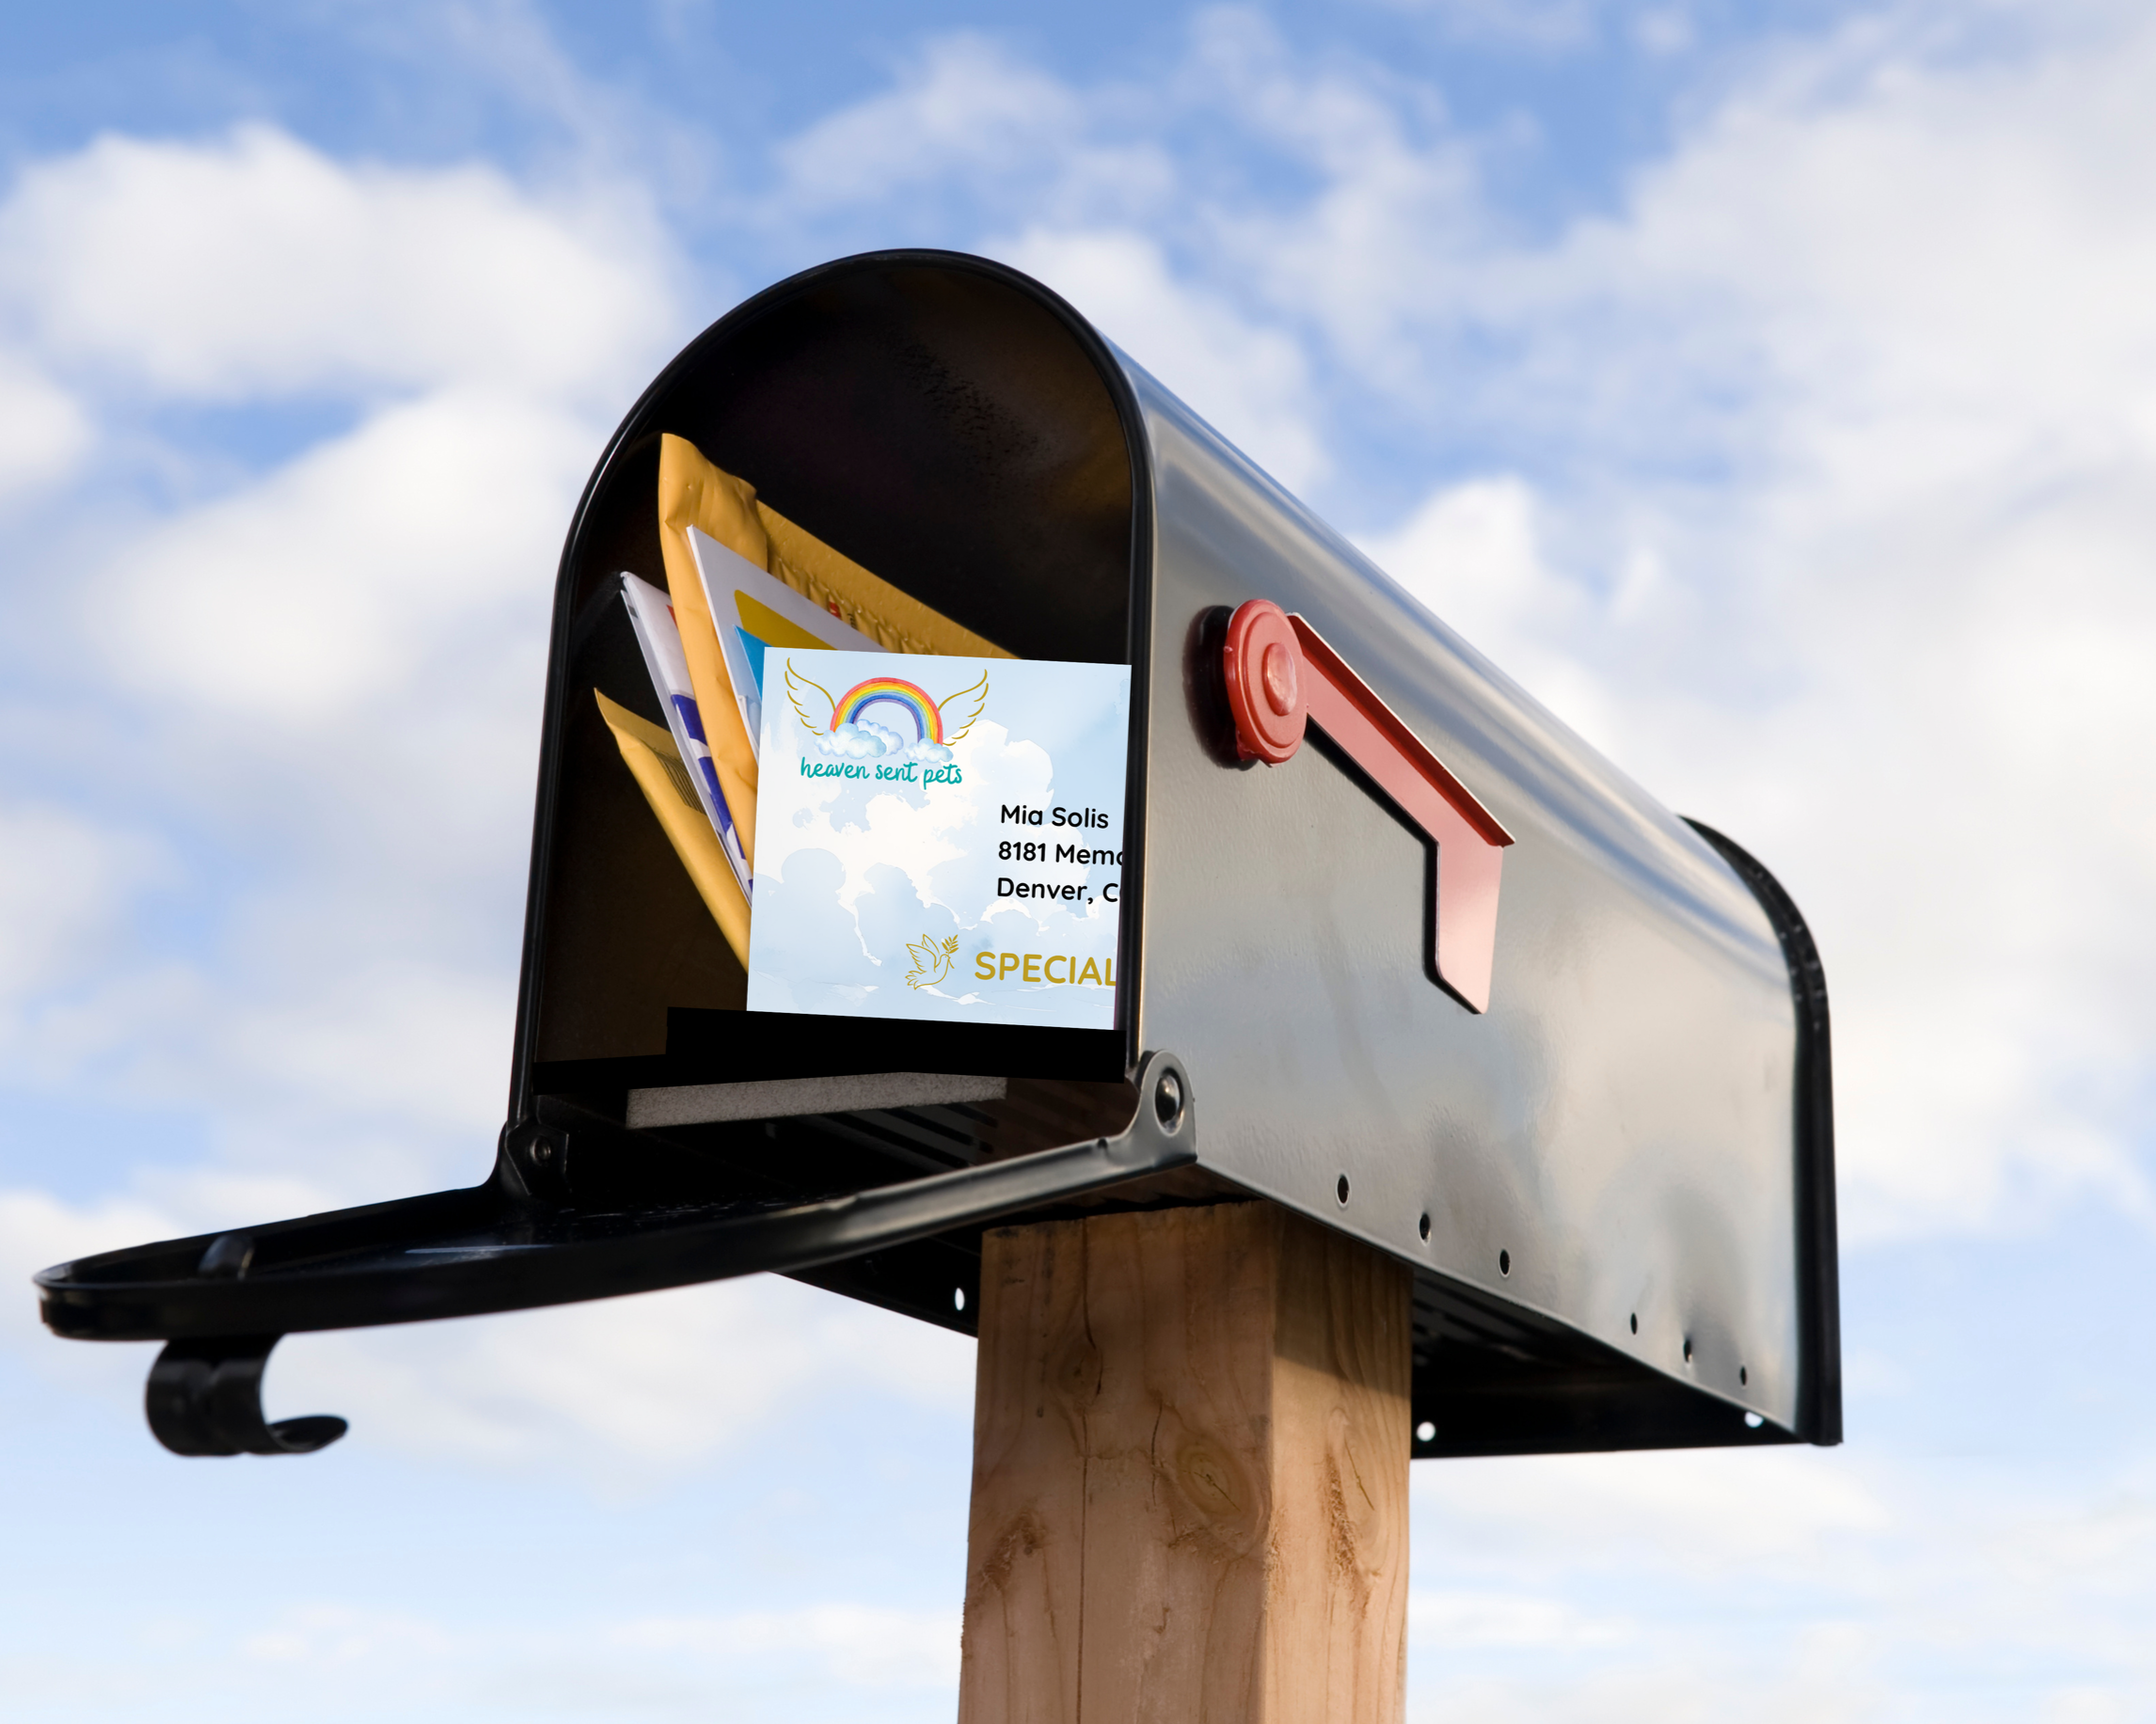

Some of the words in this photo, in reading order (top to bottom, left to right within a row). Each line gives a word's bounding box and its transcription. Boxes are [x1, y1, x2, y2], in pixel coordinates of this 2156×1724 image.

[800, 756, 870, 779] heaven
[875, 761, 918, 783] sent
[923, 763, 963, 790] pets
[1001, 804, 1043, 826] Mia
[1051, 806, 1109, 829] Solis
[998, 840, 1046, 862] 8181
[997, 877, 1094, 905] Denver,
[1102, 882, 1121, 903] C
[975, 951, 1117, 987] SPECIAL
